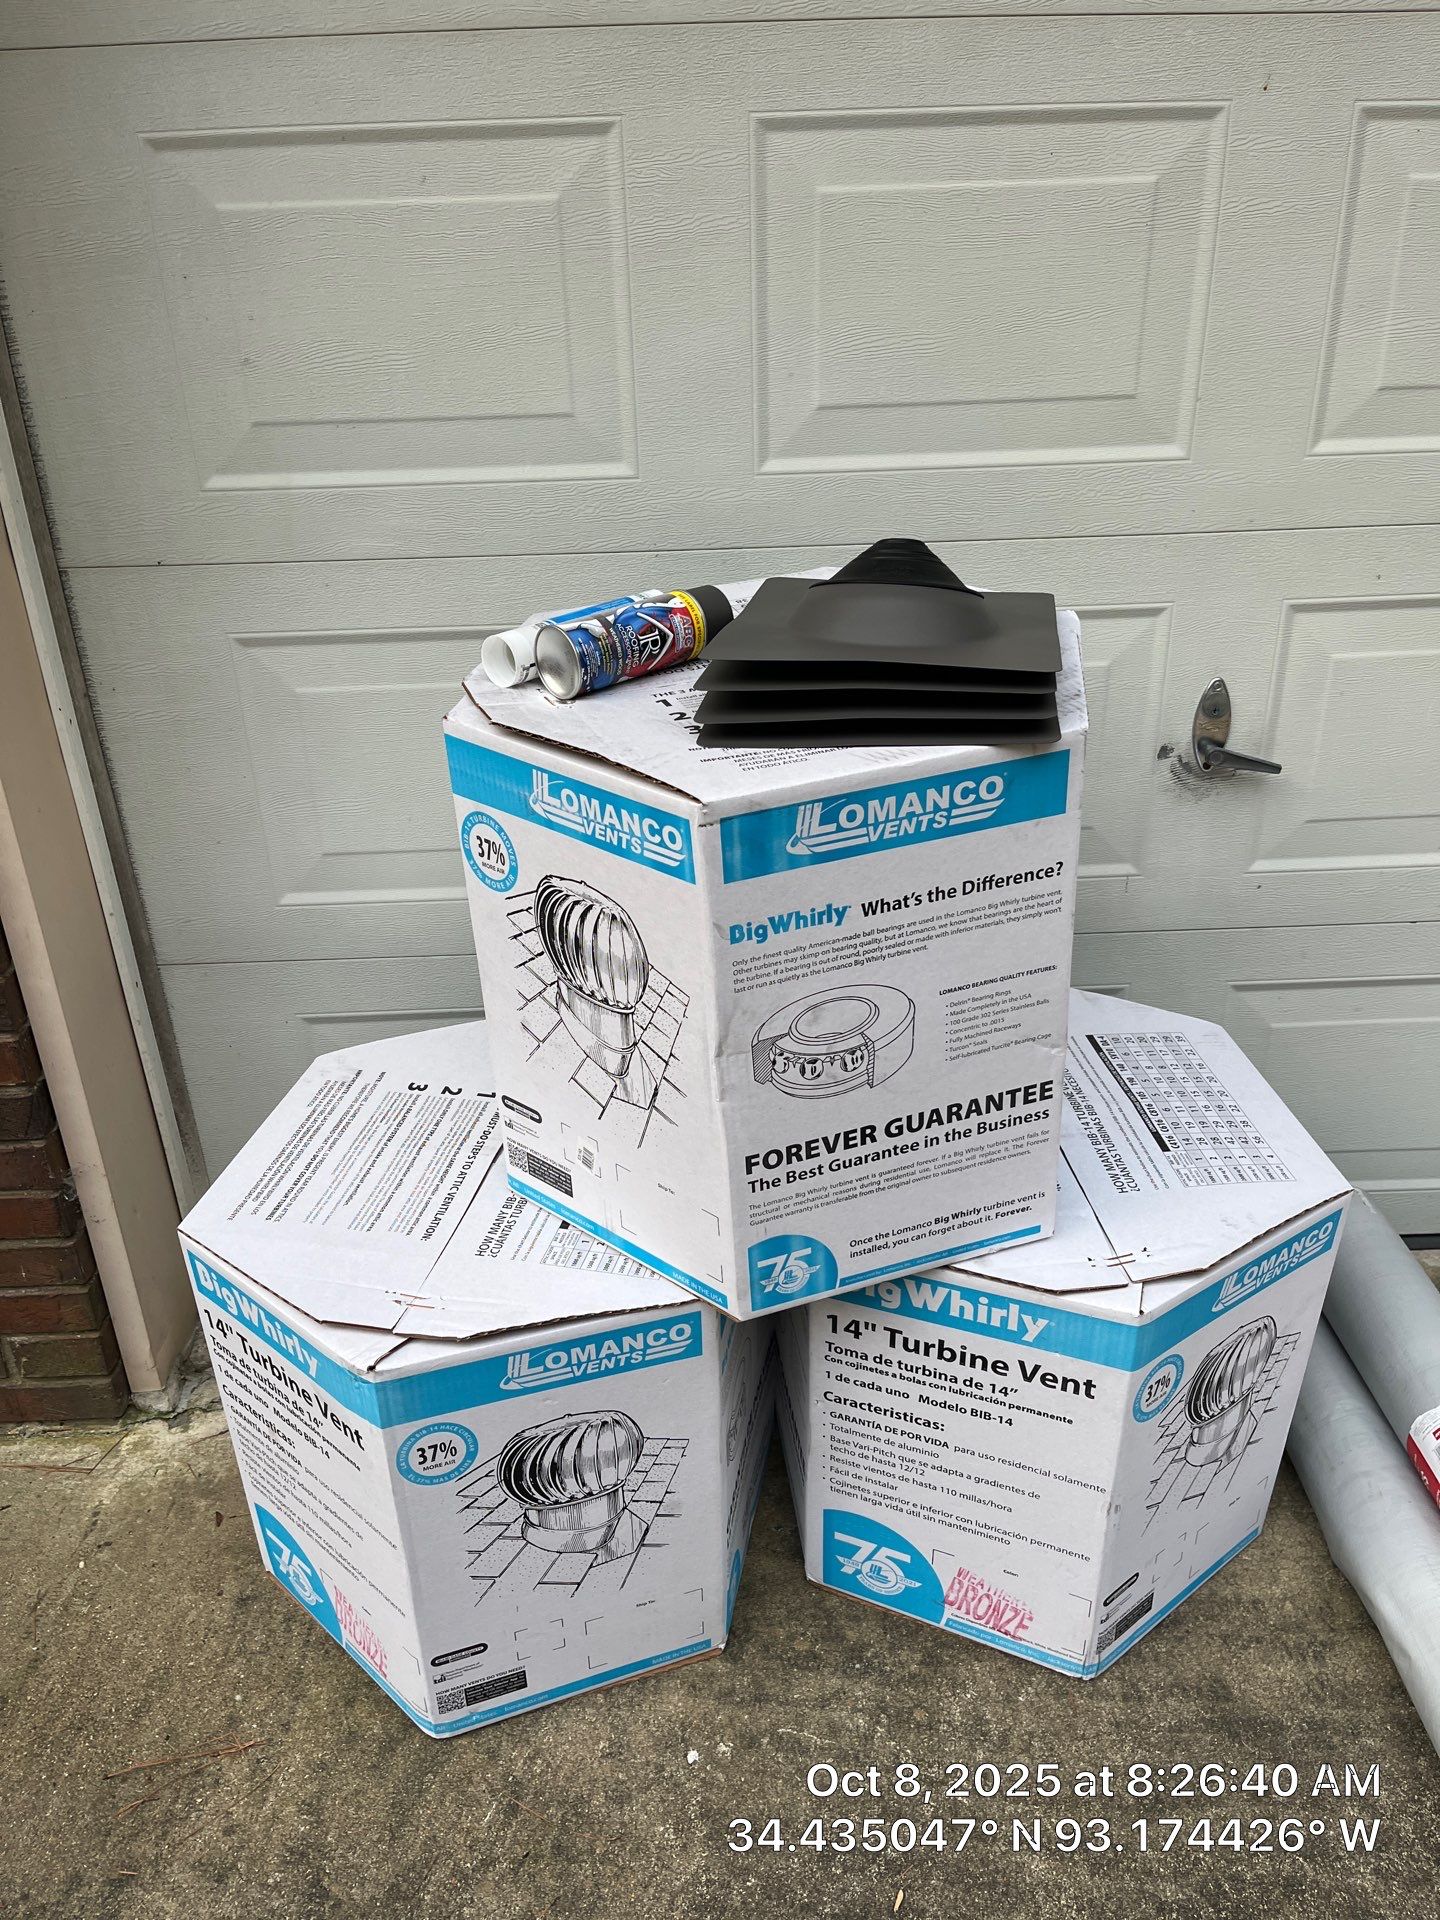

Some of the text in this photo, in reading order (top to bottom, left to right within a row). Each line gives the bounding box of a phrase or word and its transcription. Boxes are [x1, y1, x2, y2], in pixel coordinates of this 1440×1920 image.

[656, 699, 672, 707] 1
[668, 711, 692, 721] 2
[531, 769, 683, 851] LOMANCO
[796, 775, 1004, 838] LOMANCO
[867, 810, 951, 842] VENTS
[475, 835, 506, 867] 37%
[582, 818, 643, 855] VENTS
[728, 861, 1063, 945] BigWhirly What's the Difference?
[939, 964, 1057, 995] LOMANCO BEARING QUALITY FEATURES:
[407, 1081, 429, 1092] 3
[440, 1085, 463, 1096] 2
[476, 1091, 497, 1099] 1
[1078, 1095, 1097, 1116] BIB-14
[468, 1140, 485, 1160] STEPS
[744, 1079, 1053, 1175] FOREVER GUARANTEE
[747, 1109, 1049, 1193] The Best Guarantee in the Business
[1082, 1121, 1102, 1146] BIB-14
[1093, 1116, 1117, 1154] TURBINAS
[450, 1170, 468, 1191] ATTIC
[461, 1159, 474, 1170] TO
[1097, 1146, 1116, 1172] MANY
[1111, 1172, 1128, 1194] HOW
[420, 1192, 457, 1241] VENTILATION:
[475, 1209, 505, 1257] HOW MANY
[849, 1236, 873, 1247] Once
[874, 1232, 889, 1240] the
[891, 1220, 932, 1236] Lomanco
[934, 1215, 949, 1224] Big
[950, 1207, 981, 1220] Whirly
[983, 1199, 1015, 1211] turbine
[1017, 1193, 1036, 1202] vent
[849, 1241, 890, 1258] installed,
[891, 1237, 909, 1248] you
[910, 1232, 926, 1241] can
[928, 1224, 955, 1236] forget
[956, 1217, 982, 1229] about
[995, 1205, 1032, 1219] Forever.
[757, 1247, 812, 1293] 75
[1220, 1221, 1333, 1299] LOMANCO
[1255, 1254, 1300, 1289] VENTS
[193, 1259, 321, 1379] BigWhirly
[866, 1278, 1049, 1343] gWhirly
[508, 1323, 692, 1377] LOMANCO
[571, 1353, 644, 1377] VENTS
[824, 1340, 868, 1361] Toma
[872, 1353, 893, 1367] de
[896, 1359, 958, 1384] turbina
[962, 1376, 983, 1390] de
[826, 1313, 1096, 1399] 14" Turbine Vent
[203, 1308, 364, 1451] 14" Turbine Vent
[209, 1334, 237, 1362] Toma
[238, 1357, 251, 1373] de
[252, 1367, 290, 1404] turbina
[291, 1400, 304, 1416] de
[823, 1354, 843, 1365] Con
[844, 1360, 889, 1376] cojinetes
[899, 1372, 926, 1386] bolas
[928, 1382, 946, 1391] con
[948, 1385, 1006, 1407] lubricación
[1008, 1403, 1073, 1424] permanente
[825, 1370, 1013, 1426] 1 de cada uno Modelo BIB-14
[1145, 1371, 1171, 1403] 37%
[217, 1364, 330, 1459] 1 de cada uno Modelo BIB-14
[222, 1384, 295, 1449] Caracteristicas:
[823, 1390, 944, 1431] Caracteristicas:
[416, 1440, 458, 1466] 37%
[829, 1422, 939, 1458] Totalmente de aluminio
[829, 1411, 1106, 1493] GARANTÍA DE POR VIDA para uso residencial solamente
[422, 1459, 456, 1472] MORE AIR
[829, 1465, 898, 1490] Fácil de instalar
[829, 1454, 1012, 1512] Resiste vientos de hasta 110 millas/hora
[829, 1485, 1010, 1545] tienen larga vida útil sin mantenimiento
[829, 1477, 870, 1494] Cojinetes
[872, 1491, 910, 1506] superior
[919, 1503, 953, 1518] inferior
[955, 1515, 972, 1525] con
[975, 1519, 1027, 1541] lubricación
[1030, 1538, 1090, 1561] permanente
[834, 1531, 911, 1594] 75
[944, 1576, 1034, 1639] BRONZE
